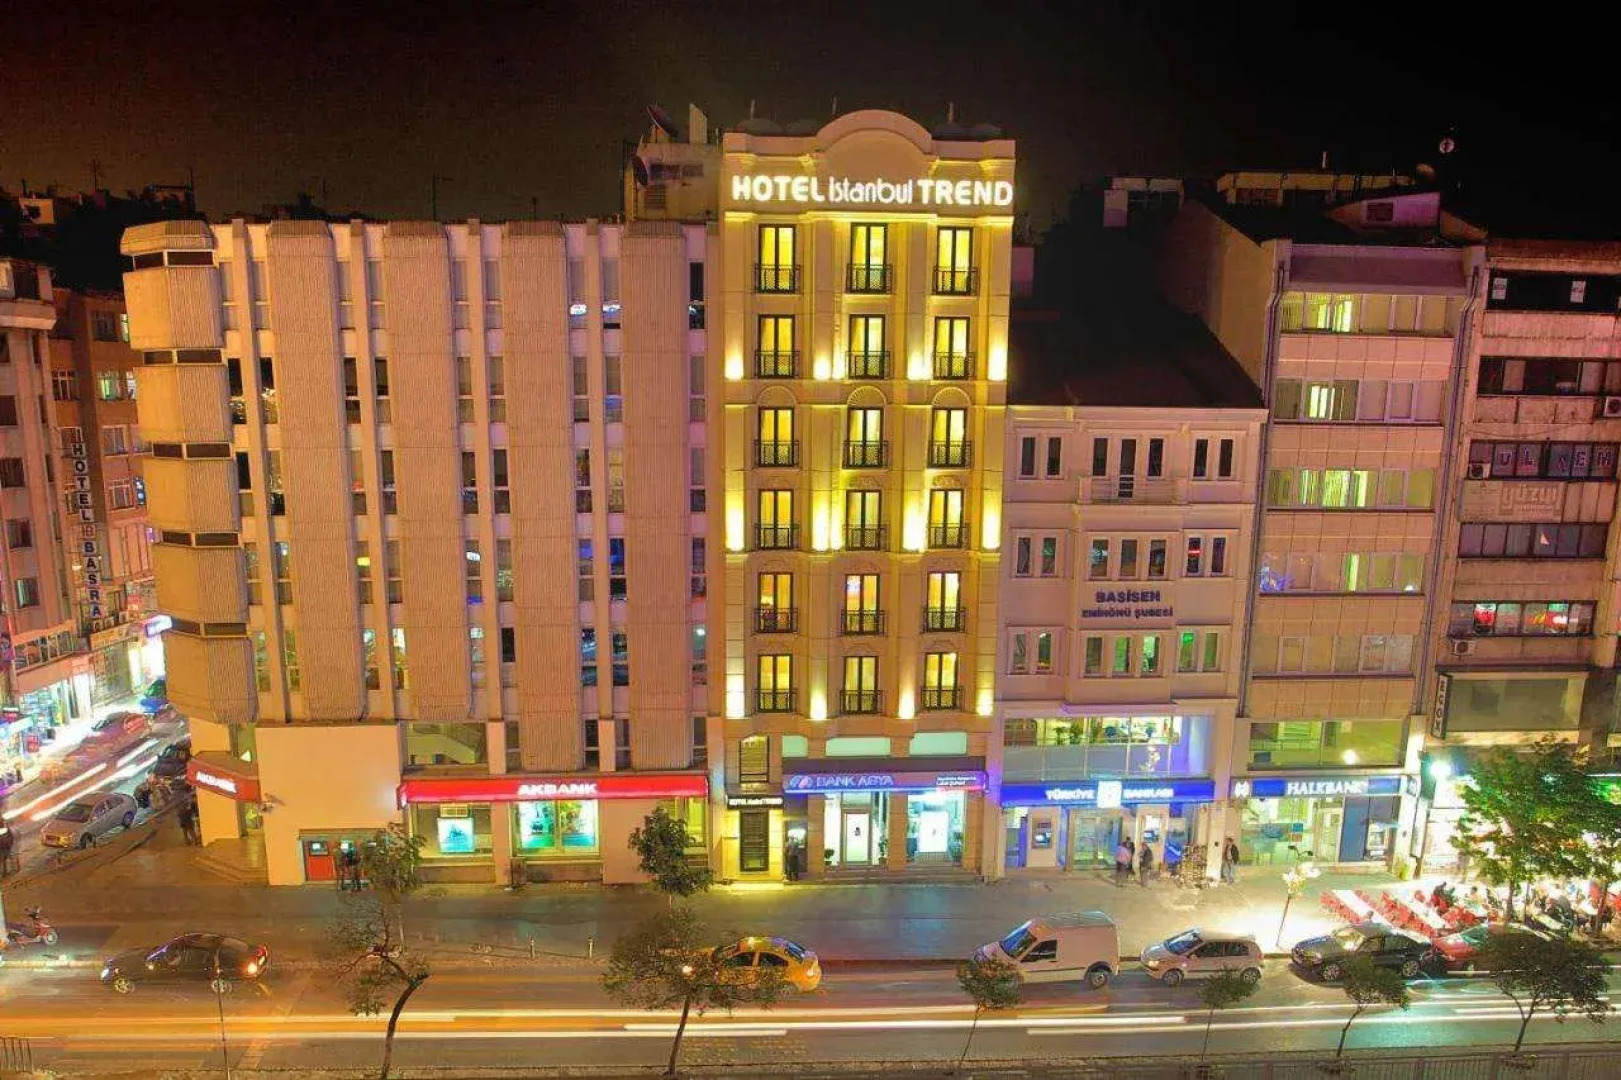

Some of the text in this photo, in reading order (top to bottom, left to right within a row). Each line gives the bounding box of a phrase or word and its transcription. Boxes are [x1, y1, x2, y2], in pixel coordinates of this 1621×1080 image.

[731, 175, 826, 203] HOTEL
[916, 178, 1014, 206] TREND
[72, 444, 92, 521] HOTEL
[84, 541, 101, 617] BASRA
[517, 783, 598, 796] AKBANK
[816, 776, 856, 787] BANK
[1287, 781, 1369, 795] HALKBANK
